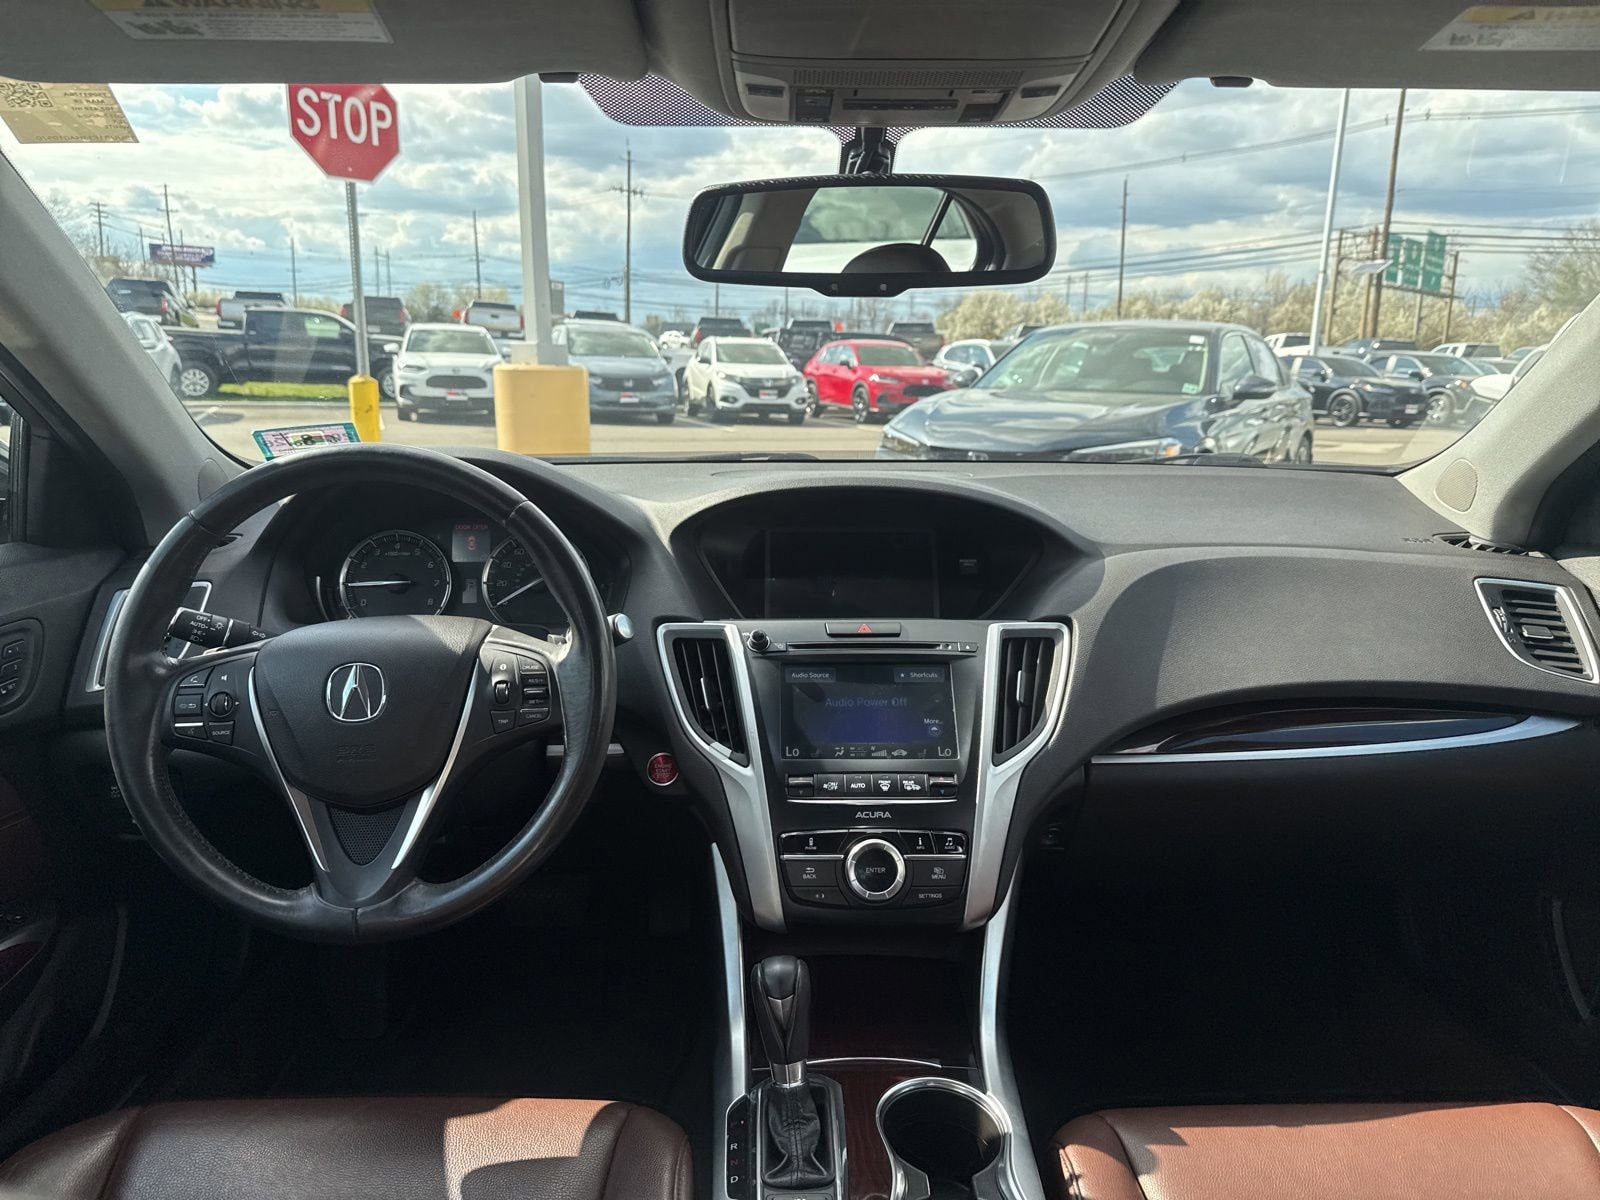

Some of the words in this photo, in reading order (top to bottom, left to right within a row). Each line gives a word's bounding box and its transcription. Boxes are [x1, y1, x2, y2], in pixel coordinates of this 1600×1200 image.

[296, 87, 392, 146] STOP
[496, 579, 507, 587] 20
[190, 621, 206, 629] AUTO
[825, 697, 853, 707] Audio
[857, 697, 888, 707] Power
[892, 697, 908, 707] Off
[730, 1143, 738, 1151] R
[730, 1175, 739, 1184] D
